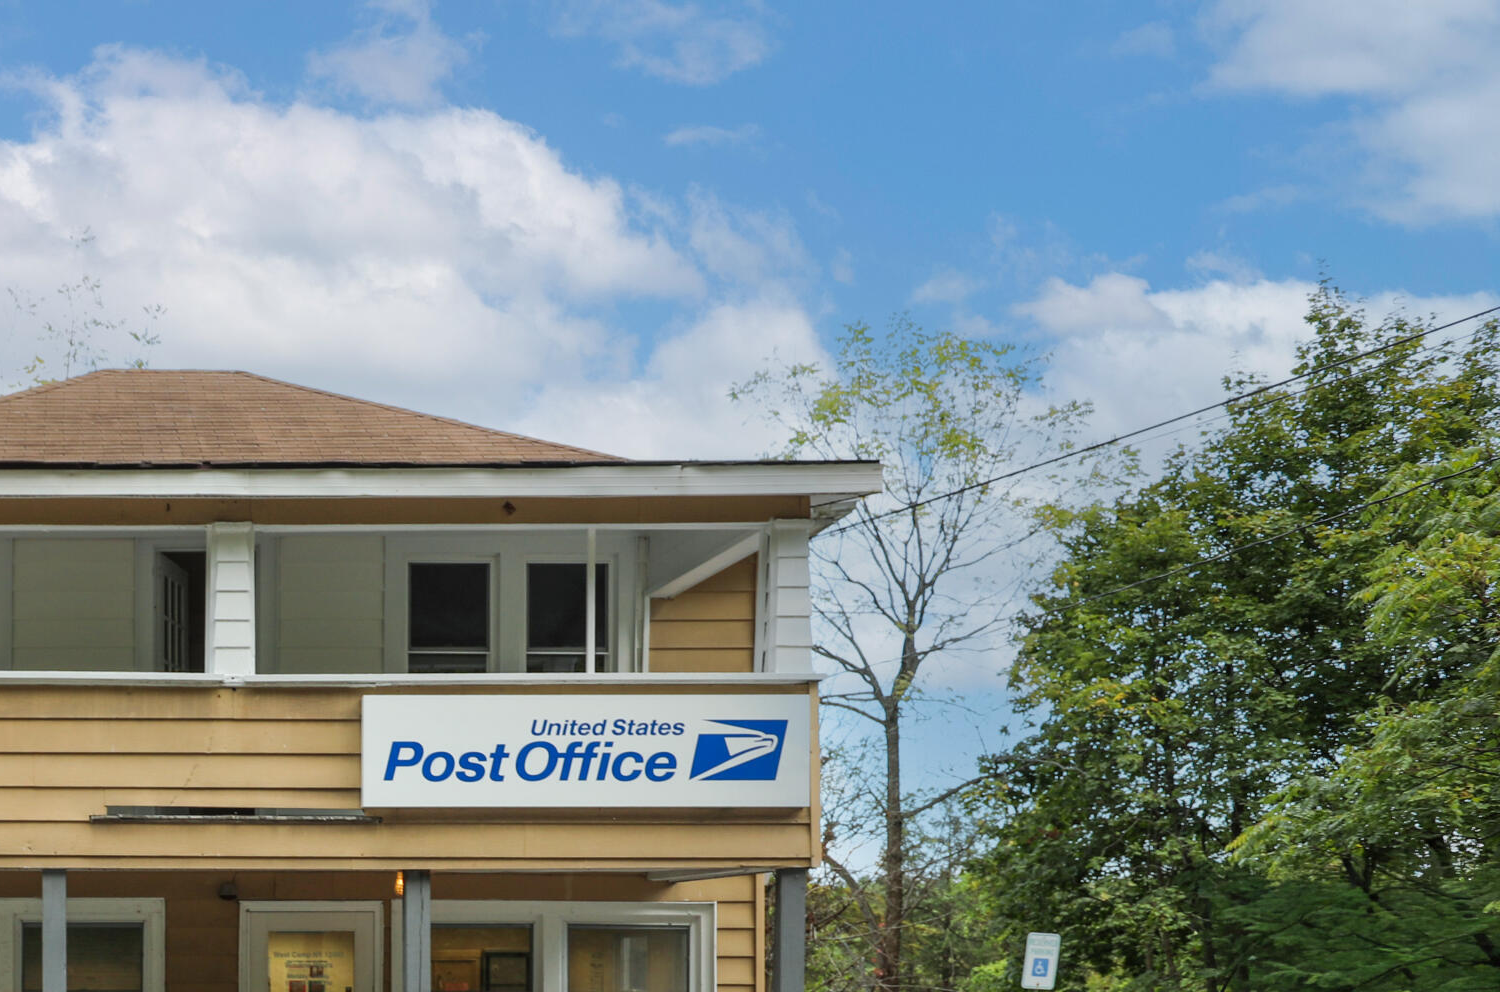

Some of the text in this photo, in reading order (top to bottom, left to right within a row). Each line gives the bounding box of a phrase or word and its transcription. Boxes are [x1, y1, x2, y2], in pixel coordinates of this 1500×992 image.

[530, 719, 685, 736] United States
[383, 740, 677, 783] Post Office
